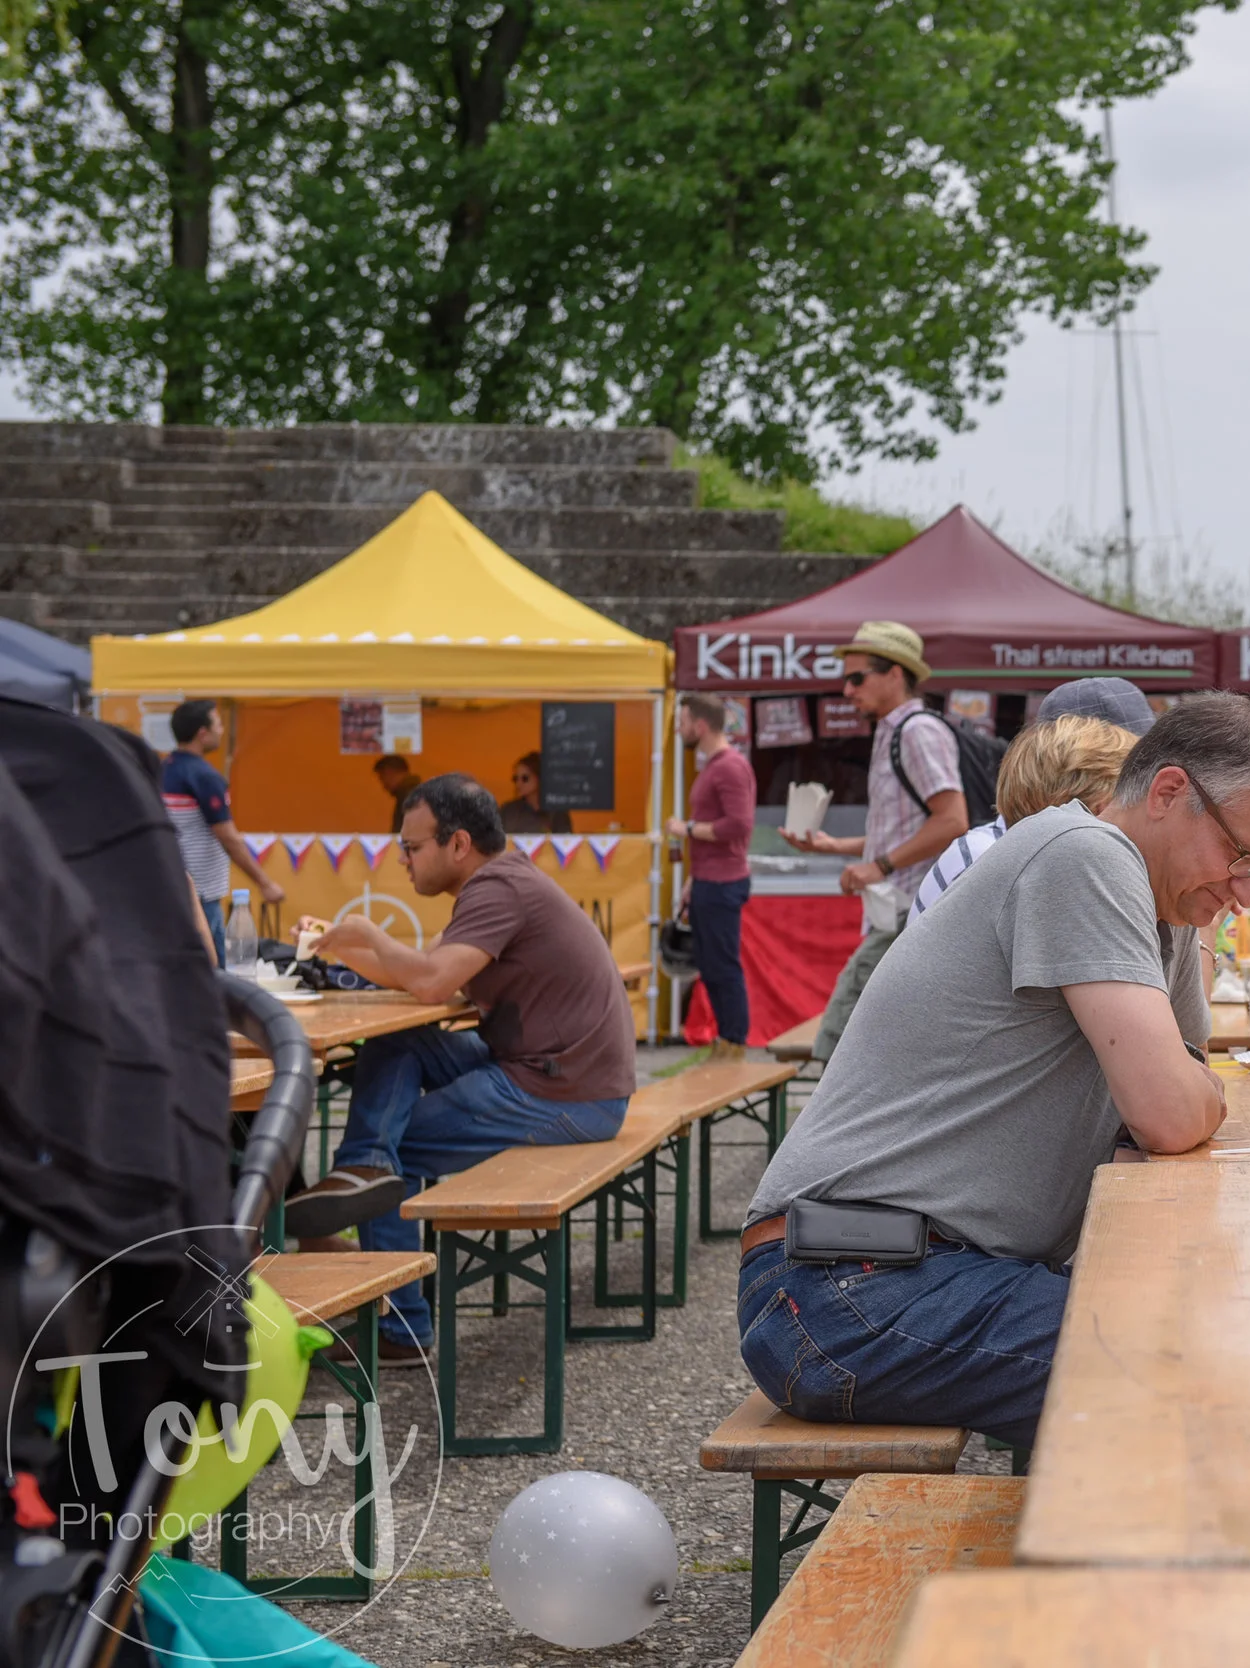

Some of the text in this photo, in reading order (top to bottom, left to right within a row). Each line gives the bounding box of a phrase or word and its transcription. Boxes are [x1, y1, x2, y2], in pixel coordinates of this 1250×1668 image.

[697, 633, 844, 679] Kinka
[992, 644, 1194, 667] Thai street Kitchen
